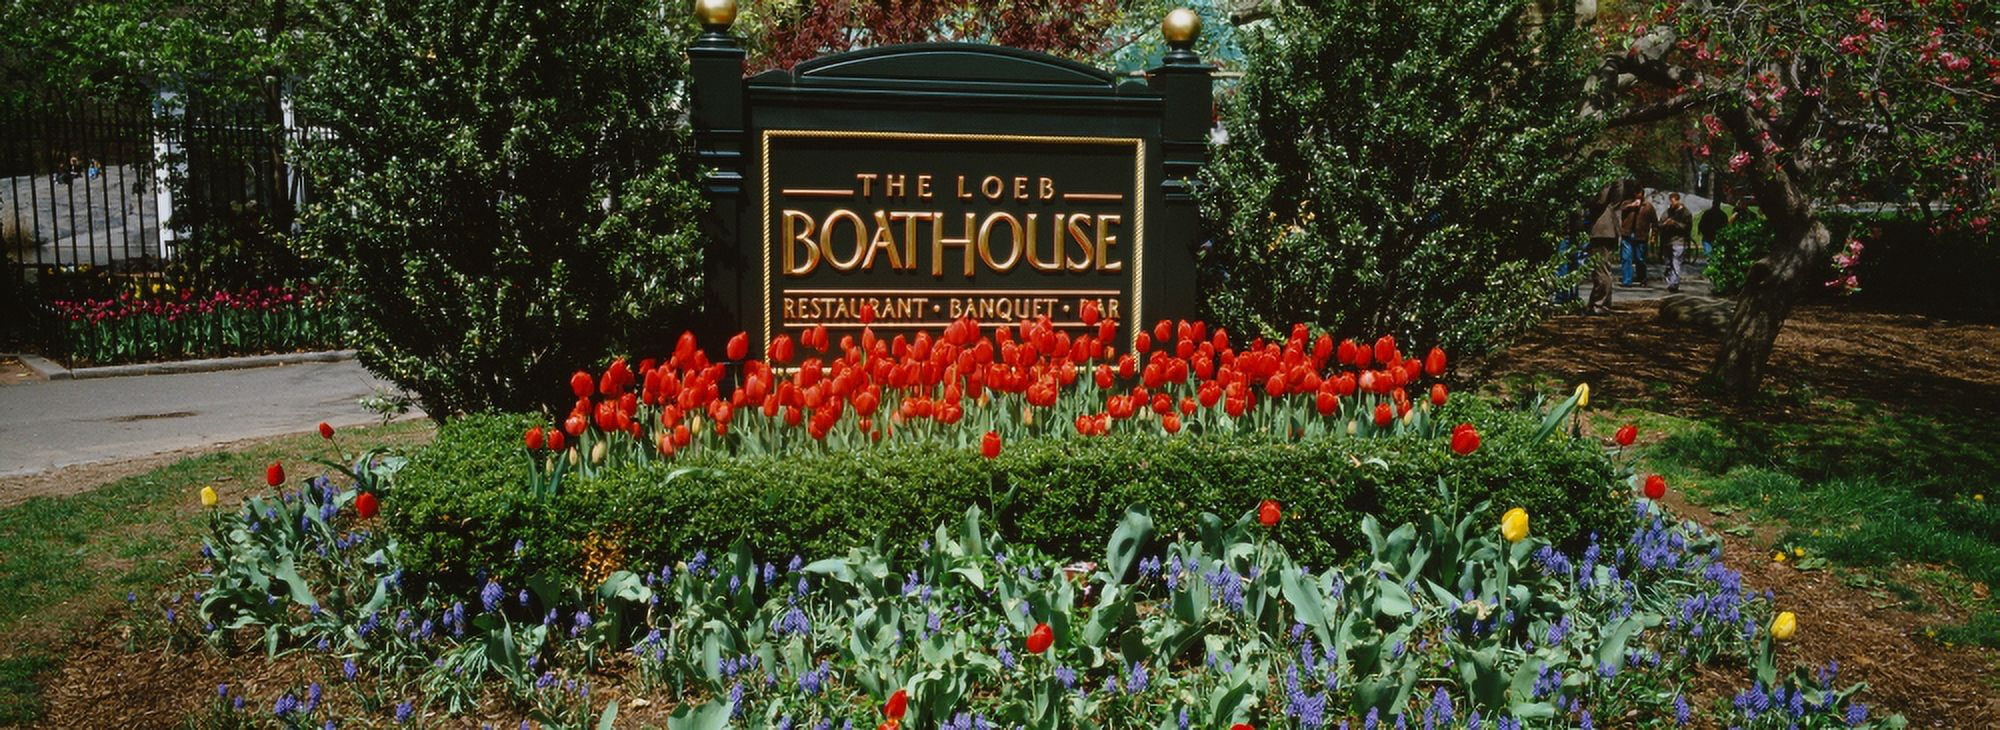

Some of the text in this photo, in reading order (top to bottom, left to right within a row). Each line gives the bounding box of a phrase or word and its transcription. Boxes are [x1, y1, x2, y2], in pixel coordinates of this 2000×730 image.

[857, 173, 1056, 199] THE LOEB
[782, 209, 1123, 277] BOATHOUSE
[784, 297, 1121, 322] RESTAURANT BANQUET AR
